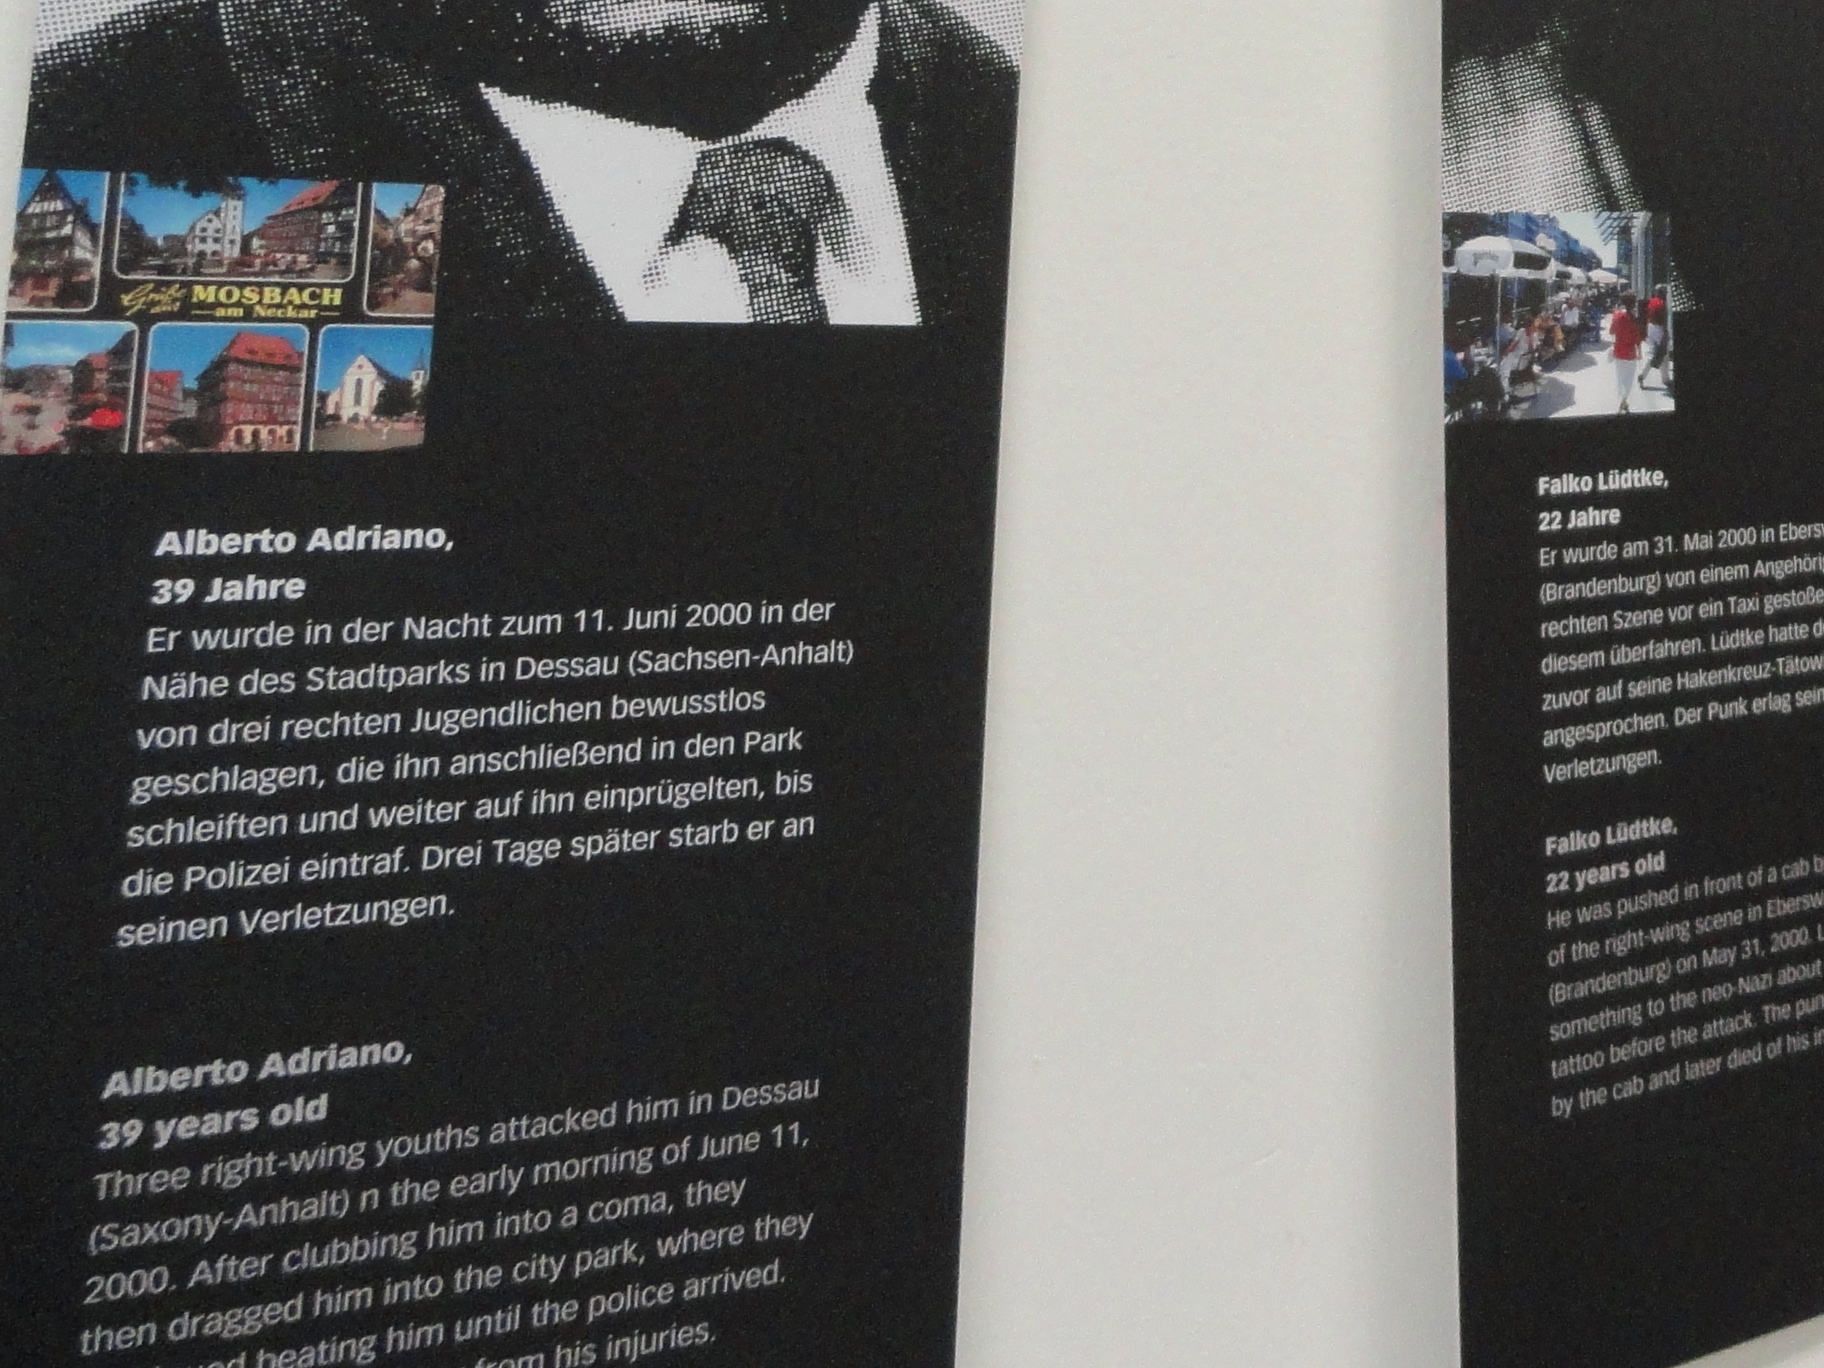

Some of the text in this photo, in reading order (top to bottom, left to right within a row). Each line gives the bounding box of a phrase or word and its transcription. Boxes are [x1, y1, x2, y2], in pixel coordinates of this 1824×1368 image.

[191, 284, 343, 306] MOSBACH
[214, 304, 319, 319] am Neckar
[1537, 467, 1669, 496] Falko Lüdtke,
[154, 524, 454, 557] Alberto Adriano,
[1538, 506, 1622, 532] 22 Jahre
[1538, 546, 1558, 568] Er
[1562, 540, 1619, 565] wurde
[1621, 539, 1650, 559] am
[1683, 530, 1714, 552] Mai
[1717, 526, 1758, 549] 2000
[1760, 527, 1776, 544] in
[150, 574, 307, 605] 39 Jahre
[1539, 570, 1662, 605] (Brandenburg)
[1664, 569, 1696, 589] von
[1698, 563, 1750, 585] einem
[146, 598, 836, 653] Er wurde in der Nacht zum 11. Juni 2000 in der
[1540, 614, 1609, 639] rechten
[1612, 607, 1665, 630] Szene
[1667, 604, 1695, 623] vor
[1697, 599, 1724, 620] ein
[1727, 595, 1760, 615] Taxi
[141, 638, 854, 701] Nähe des Stadtparks in Dessau (Sachsen-Anhalt)
[1540, 650, 1606, 676] diesem
[1710, 627, 1766, 653] Lüdtke
[1768, 622, 1810, 643] hatte
[136, 687, 766, 750] von drei rechten Jugendlichen bewusstlos
[1541, 687, 1591, 712] zuvor
[1594, 678, 1623, 704] auf
[1627, 676, 1673, 699] seine
[1673, 706, 1704, 727] Der
[1707, 696, 1749, 721] Punk
[1751, 691, 1792, 715] erlag
[129, 726, 803, 806] geschlagen, die ihn anschließend in den Park
[126, 769, 814, 848] schleiften und weiter auf ihn einprügelten, bis
[120, 815, 815, 898] die Polizei eintraf. Drei Tage später starb er an
[1545, 816, 1678, 857] Falko Lüdtke,
[1545, 850, 1666, 894] 22 years old
[116, 894, 455, 948] seinen Verletzungen.
[101, 1040, 413, 1100] Alberto Adriano,
[93, 1078, 820, 1201] Three right-wing youths attacked him in Dessau
[98, 1092, 329, 1150] 39 years old
[88, 1121, 809, 1256] (Saxony-Anhalt) n the early morning of June 11,
[83, 1177, 747, 1305] 2000. After clubbing him into a coma, they
[80, 1212, 815, 1356] then dragged him into the city park, where they
[386, 1322, 445, 1354] him
[454, 1303, 521, 1343] until
[531, 1298, 580, 1328] the
[587, 1282, 675, 1325] police
[682, 1257, 785, 1301] arrived.
[554, 1340, 597, 1368] his
[605, 1321, 716, 1364] injuries.
